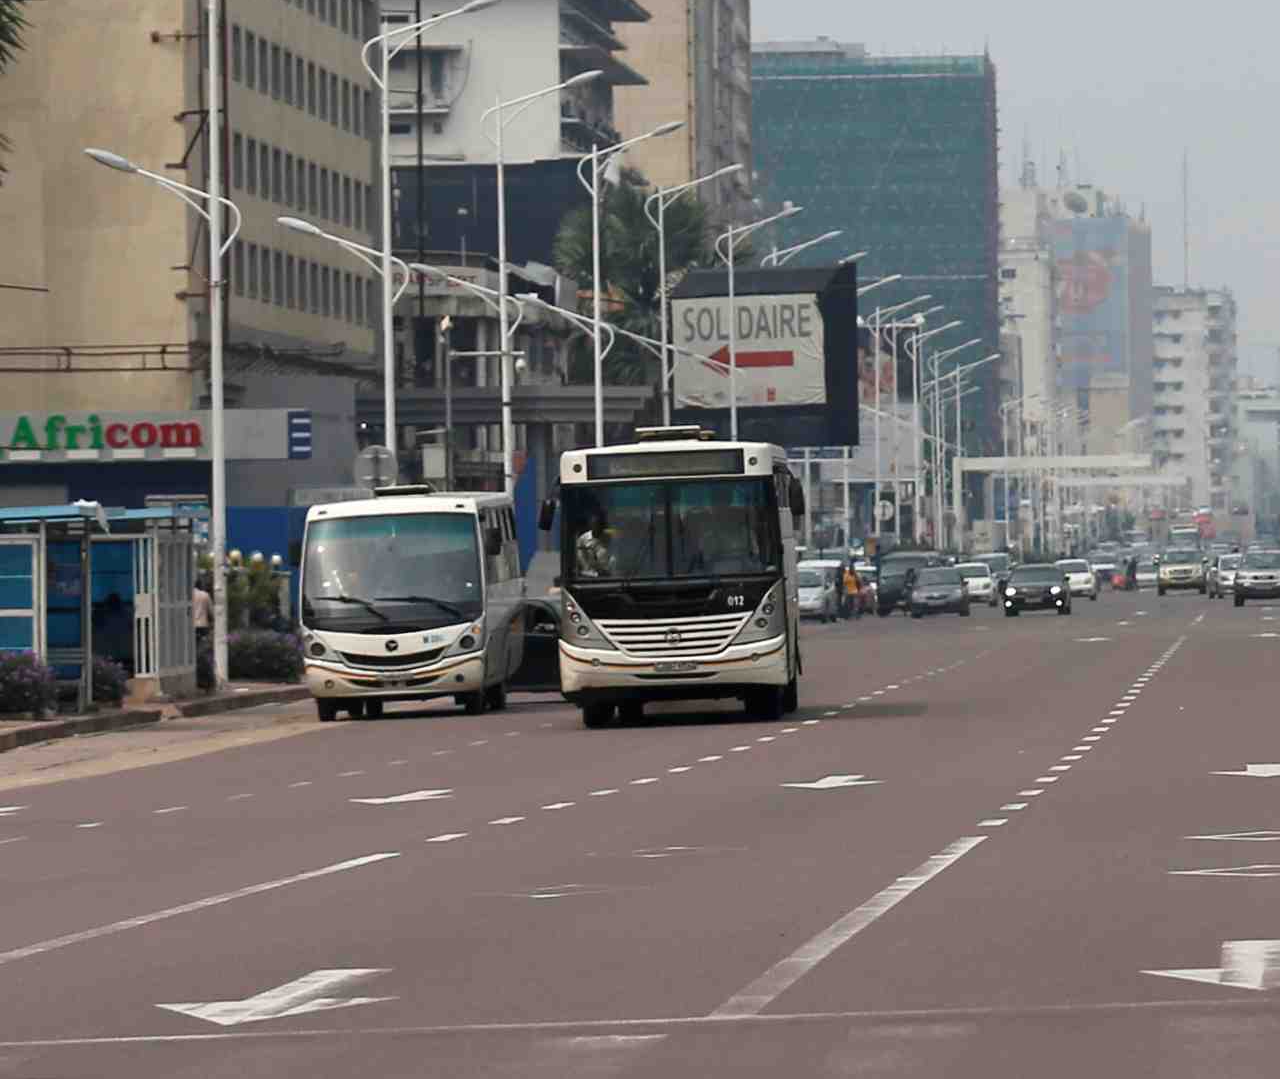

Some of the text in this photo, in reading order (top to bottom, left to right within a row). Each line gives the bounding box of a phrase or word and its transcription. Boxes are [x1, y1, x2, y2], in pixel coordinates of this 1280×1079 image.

[682, 304, 813, 342] SOLDAIRE
[11, 414, 203, 450] Africom
[727, 595, 744, 606] 012
